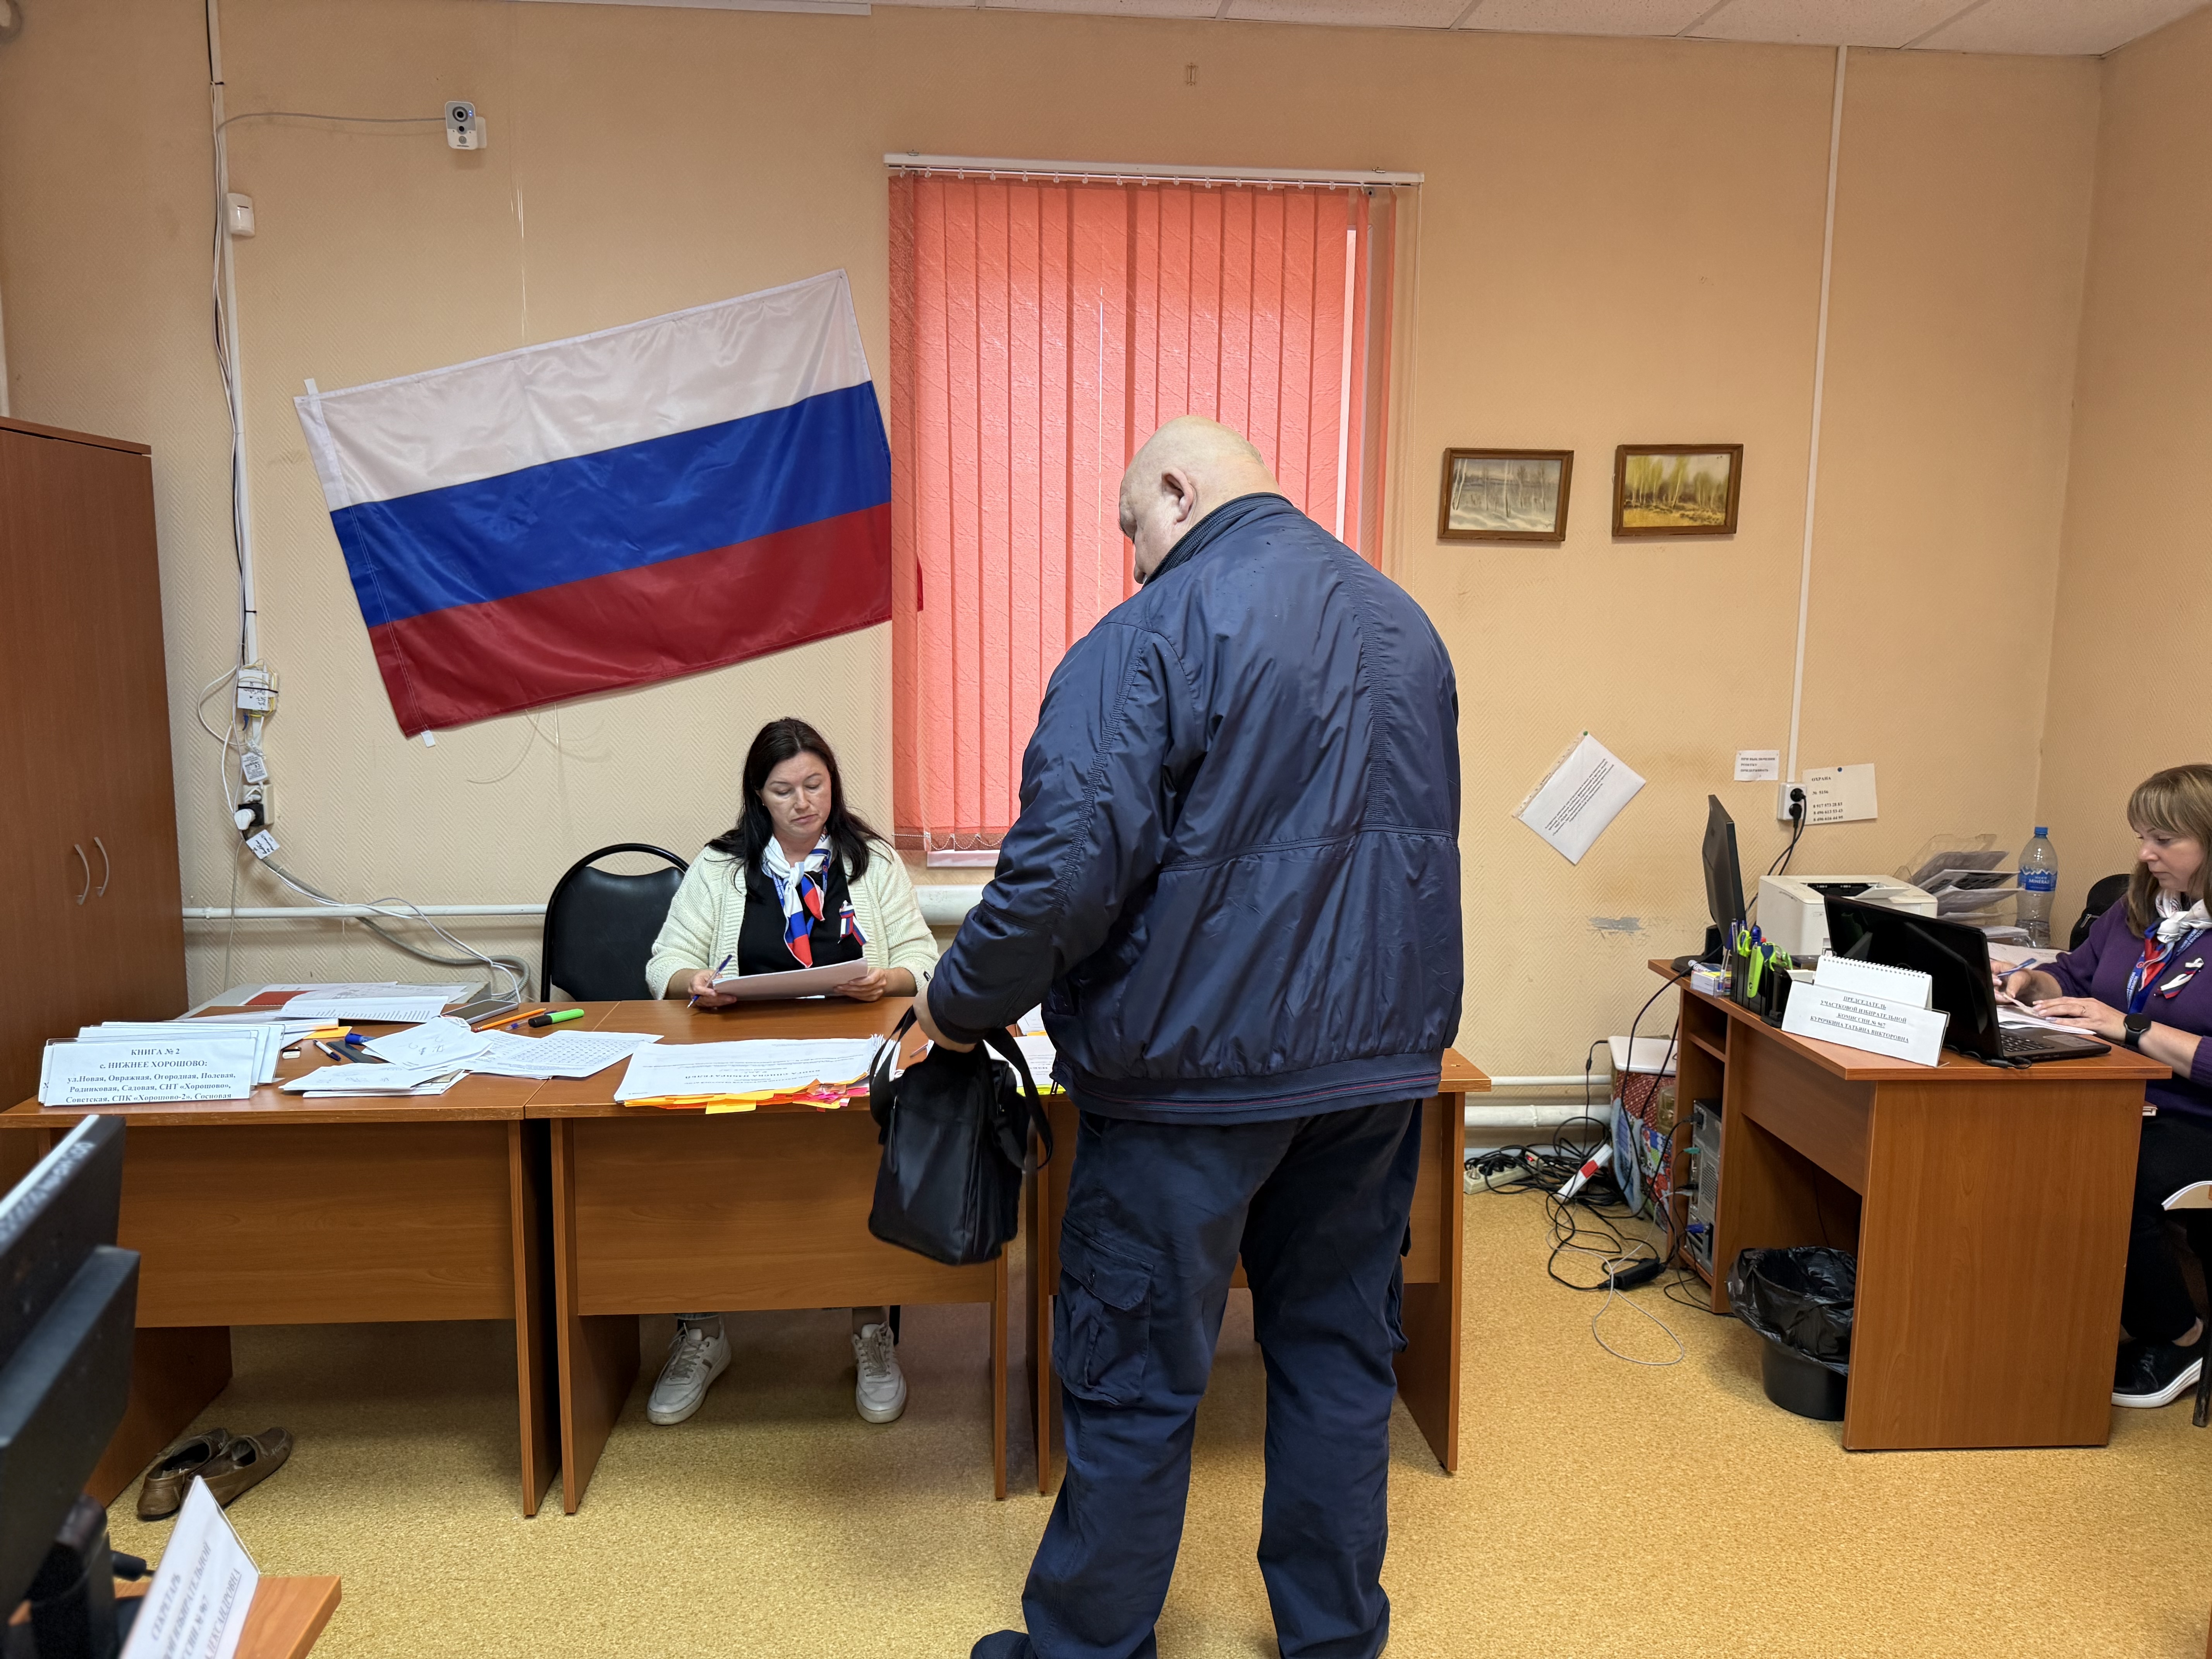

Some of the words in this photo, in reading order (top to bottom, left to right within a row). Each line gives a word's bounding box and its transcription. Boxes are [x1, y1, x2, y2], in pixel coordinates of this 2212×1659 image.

[1820, 1000, 1858, 1012] УЧАСТКОВОЙ
[1858, 1008, 1906, 1024] ИЗБИРАТЕЛЬНОЙ
[1843, 996, 1886, 1010] ПРЕДСЕДАТЕЛЬ
[1810, 1016, 1843, 1027] КУРОЧКИНА
[1844, 1023, 1870, 1034] ТАТЬЯНА
[1871, 1030, 1909, 1043] ВИКТОРОВНА
[1837, 1013, 1870, 1024] КОМИССИИ
[172, 1539, 211, 1640] ИЗБИРАТЕЛЬНОЙ
[151, 1573, 181, 1642] СЕКРЕТАРЬ
